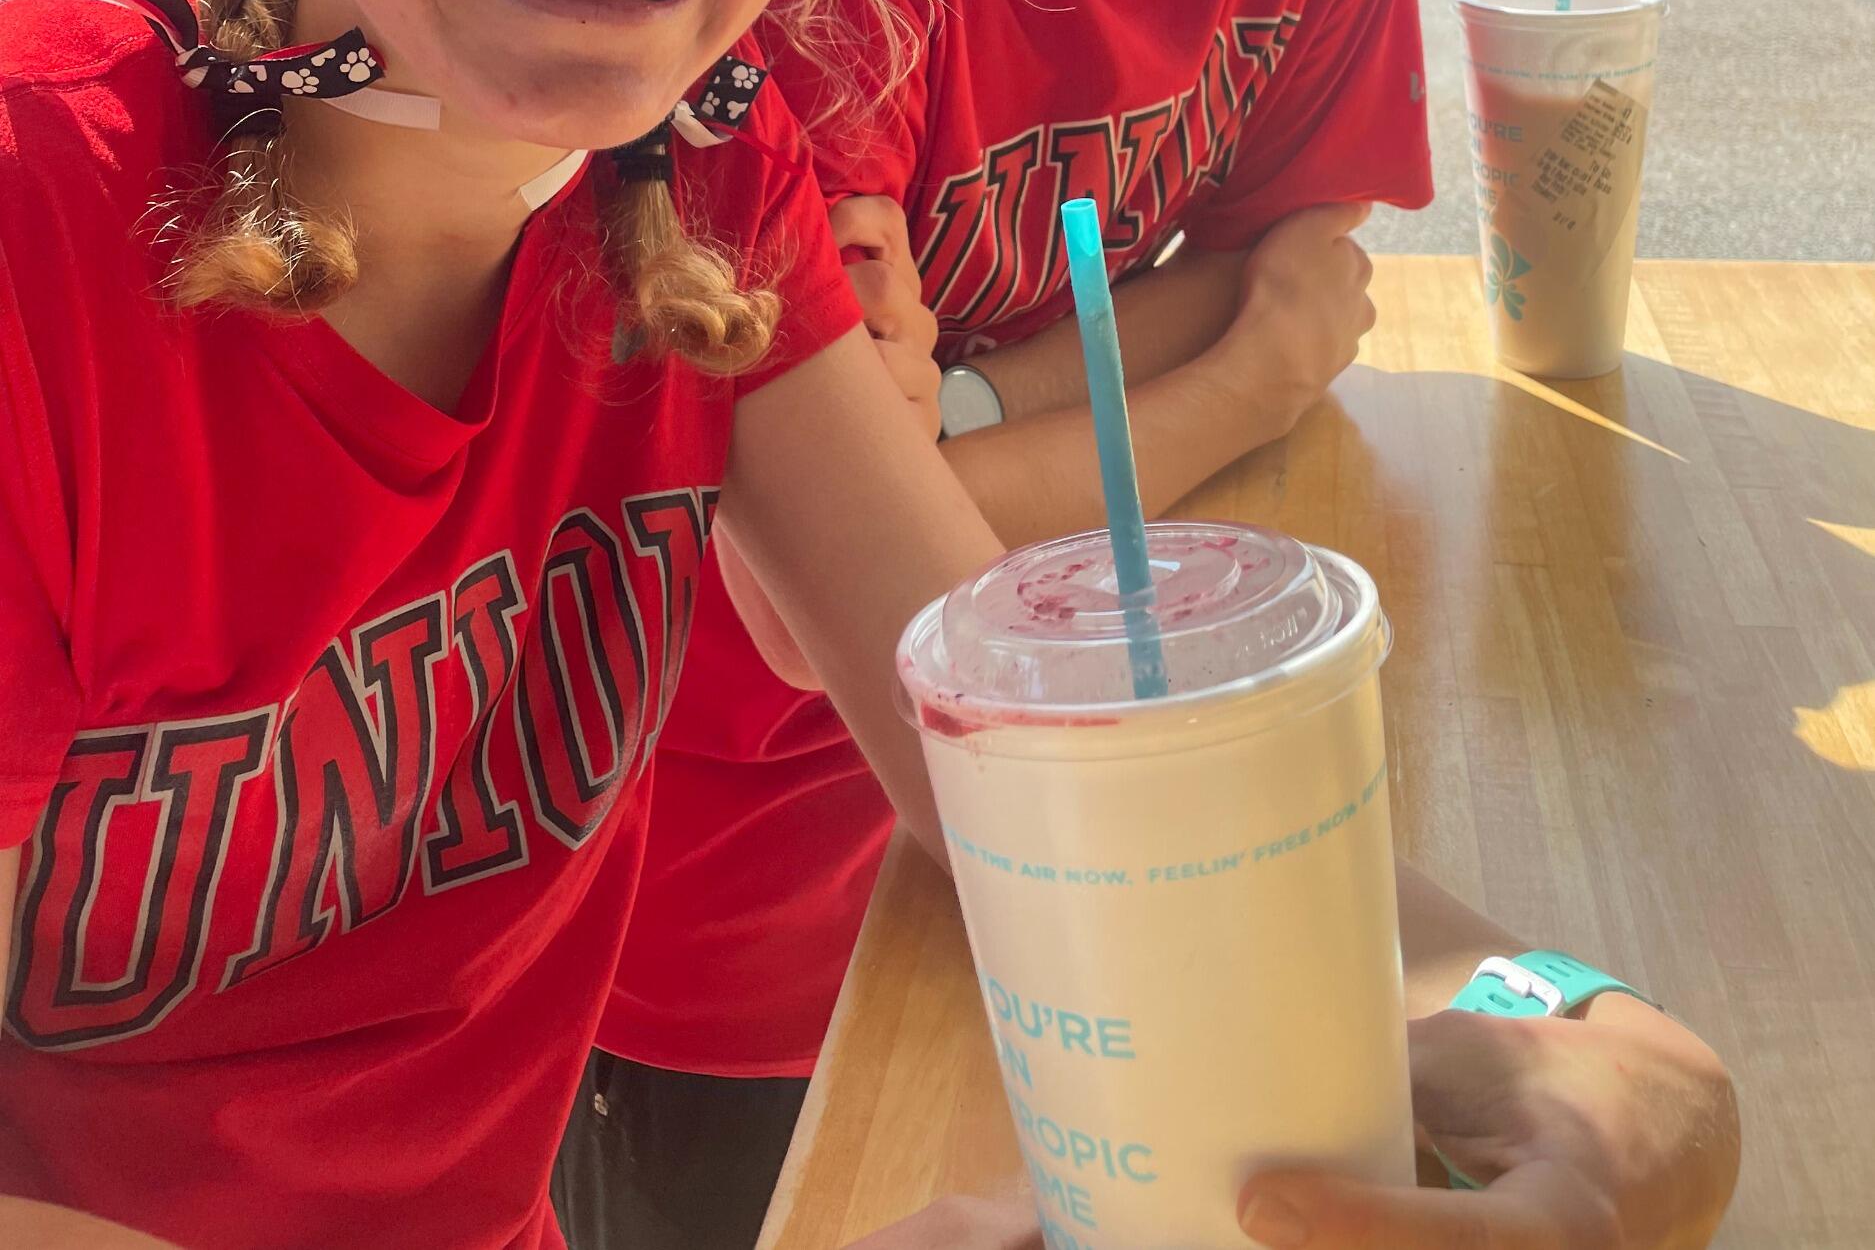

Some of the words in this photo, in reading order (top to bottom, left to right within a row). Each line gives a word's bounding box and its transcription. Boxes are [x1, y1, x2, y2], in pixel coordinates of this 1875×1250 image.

[1020, 862, 1057, 882] AIR
[1065, 868, 1134, 886] NOW.
[1147, 850, 1248, 884] FEELIN'
[1253, 827, 1312, 863] FREE
[980, 975, 1137, 1061] OU'RE
[1008, 1090, 1158, 1184] ROPIC
